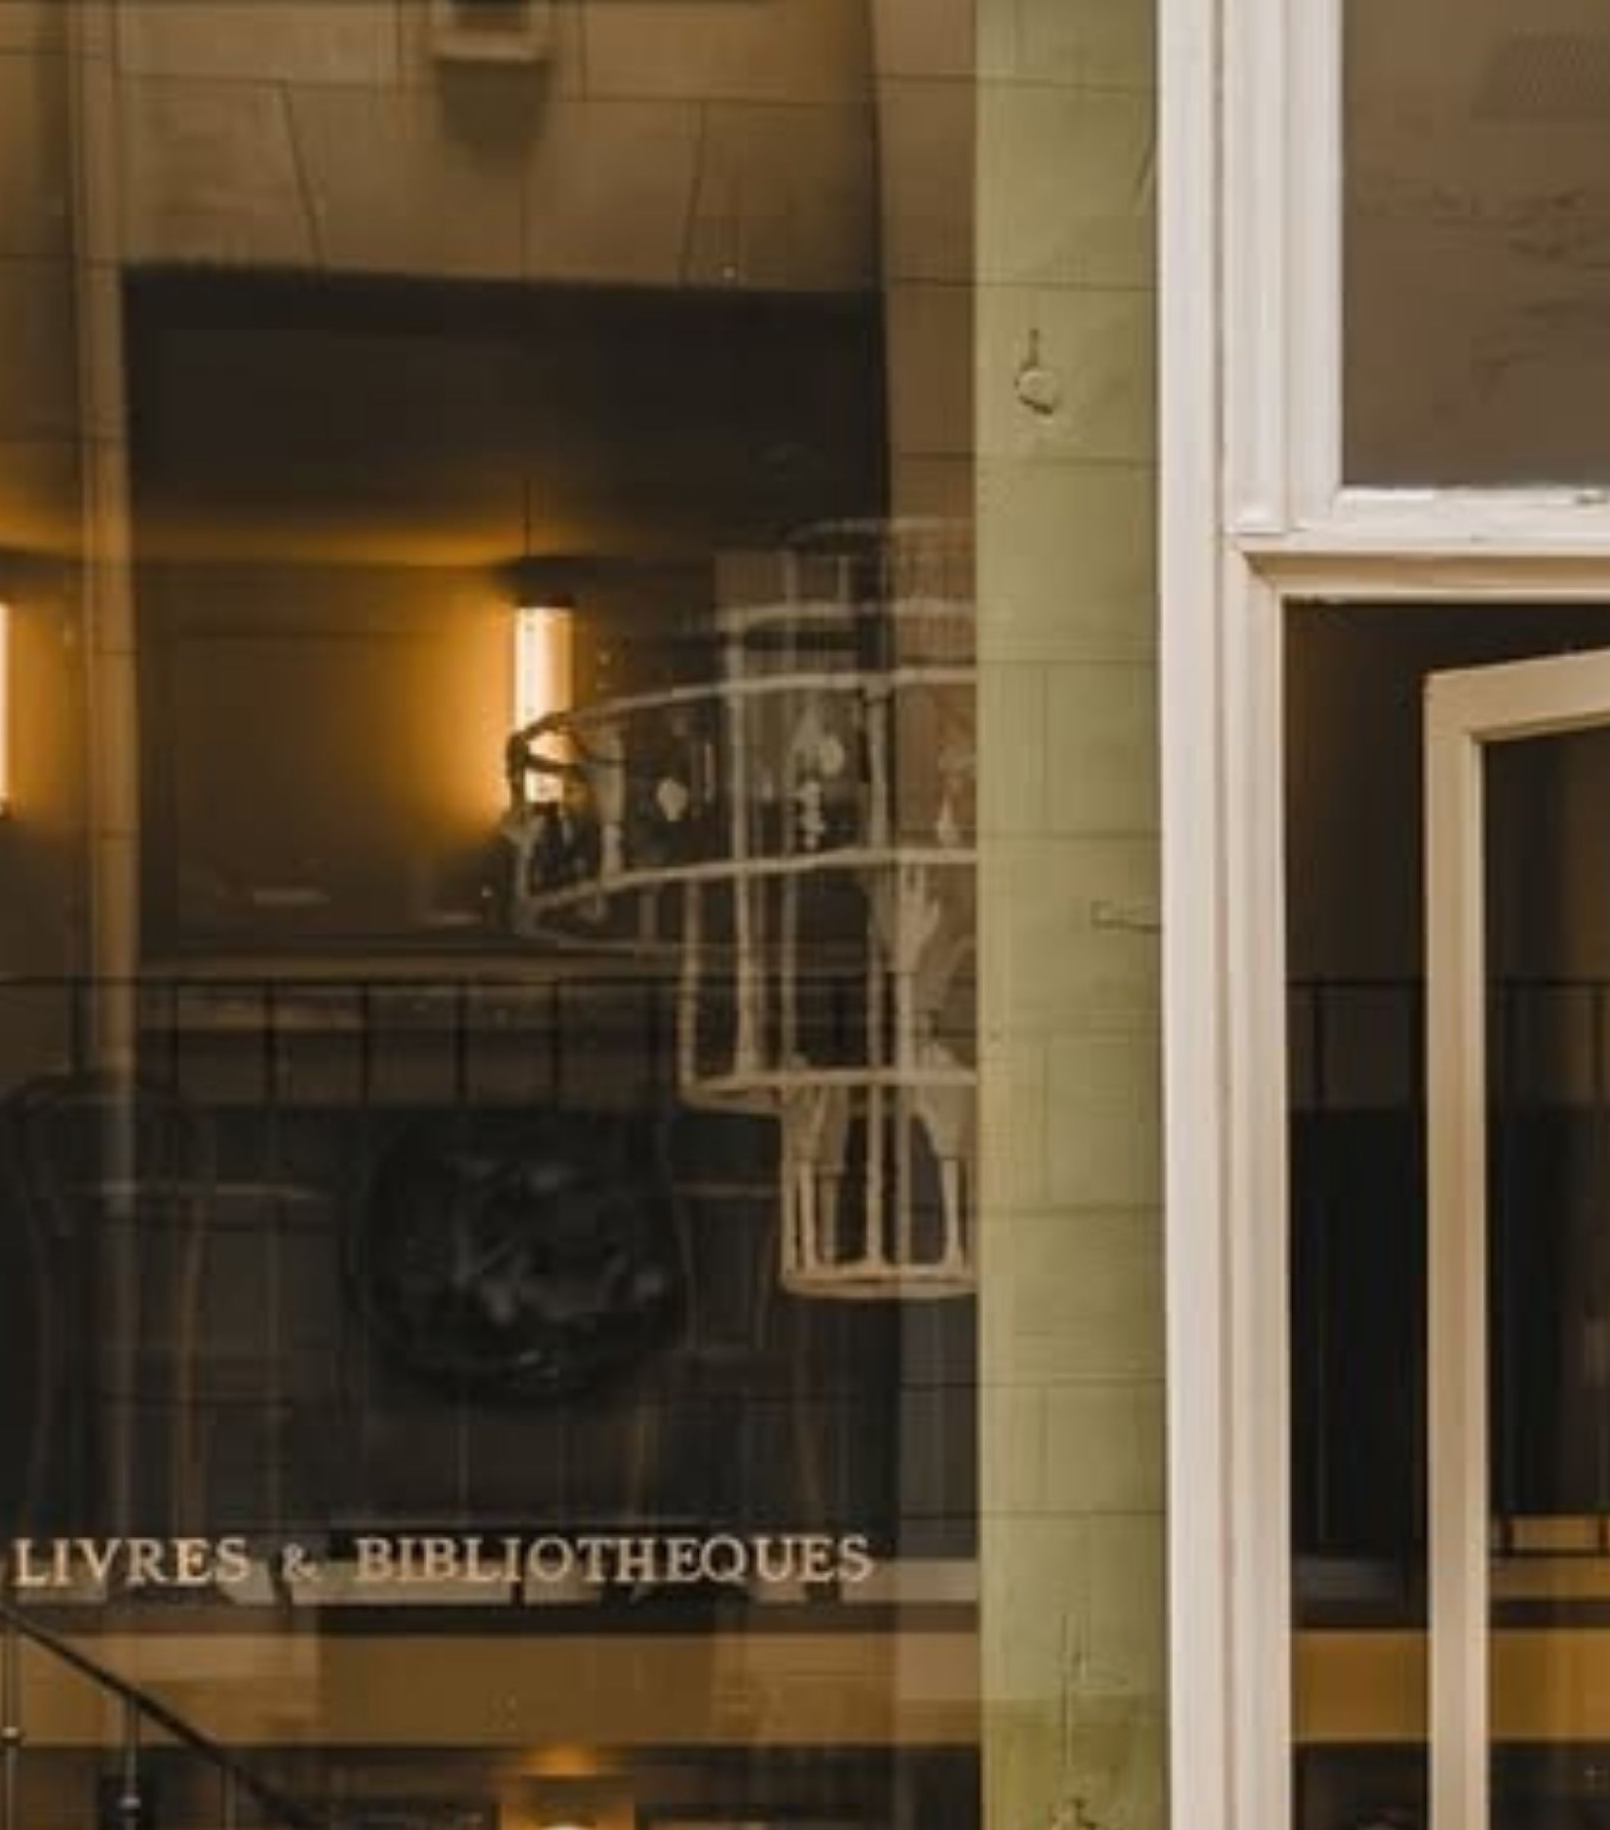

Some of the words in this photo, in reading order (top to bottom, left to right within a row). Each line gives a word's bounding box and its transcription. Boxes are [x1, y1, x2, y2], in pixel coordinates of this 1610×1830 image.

[14, 1536, 250, 1585] LIVRES
[282, 1543, 321, 1579] &
[355, 1534, 875, 1584] BIBLIOTHEQUES
